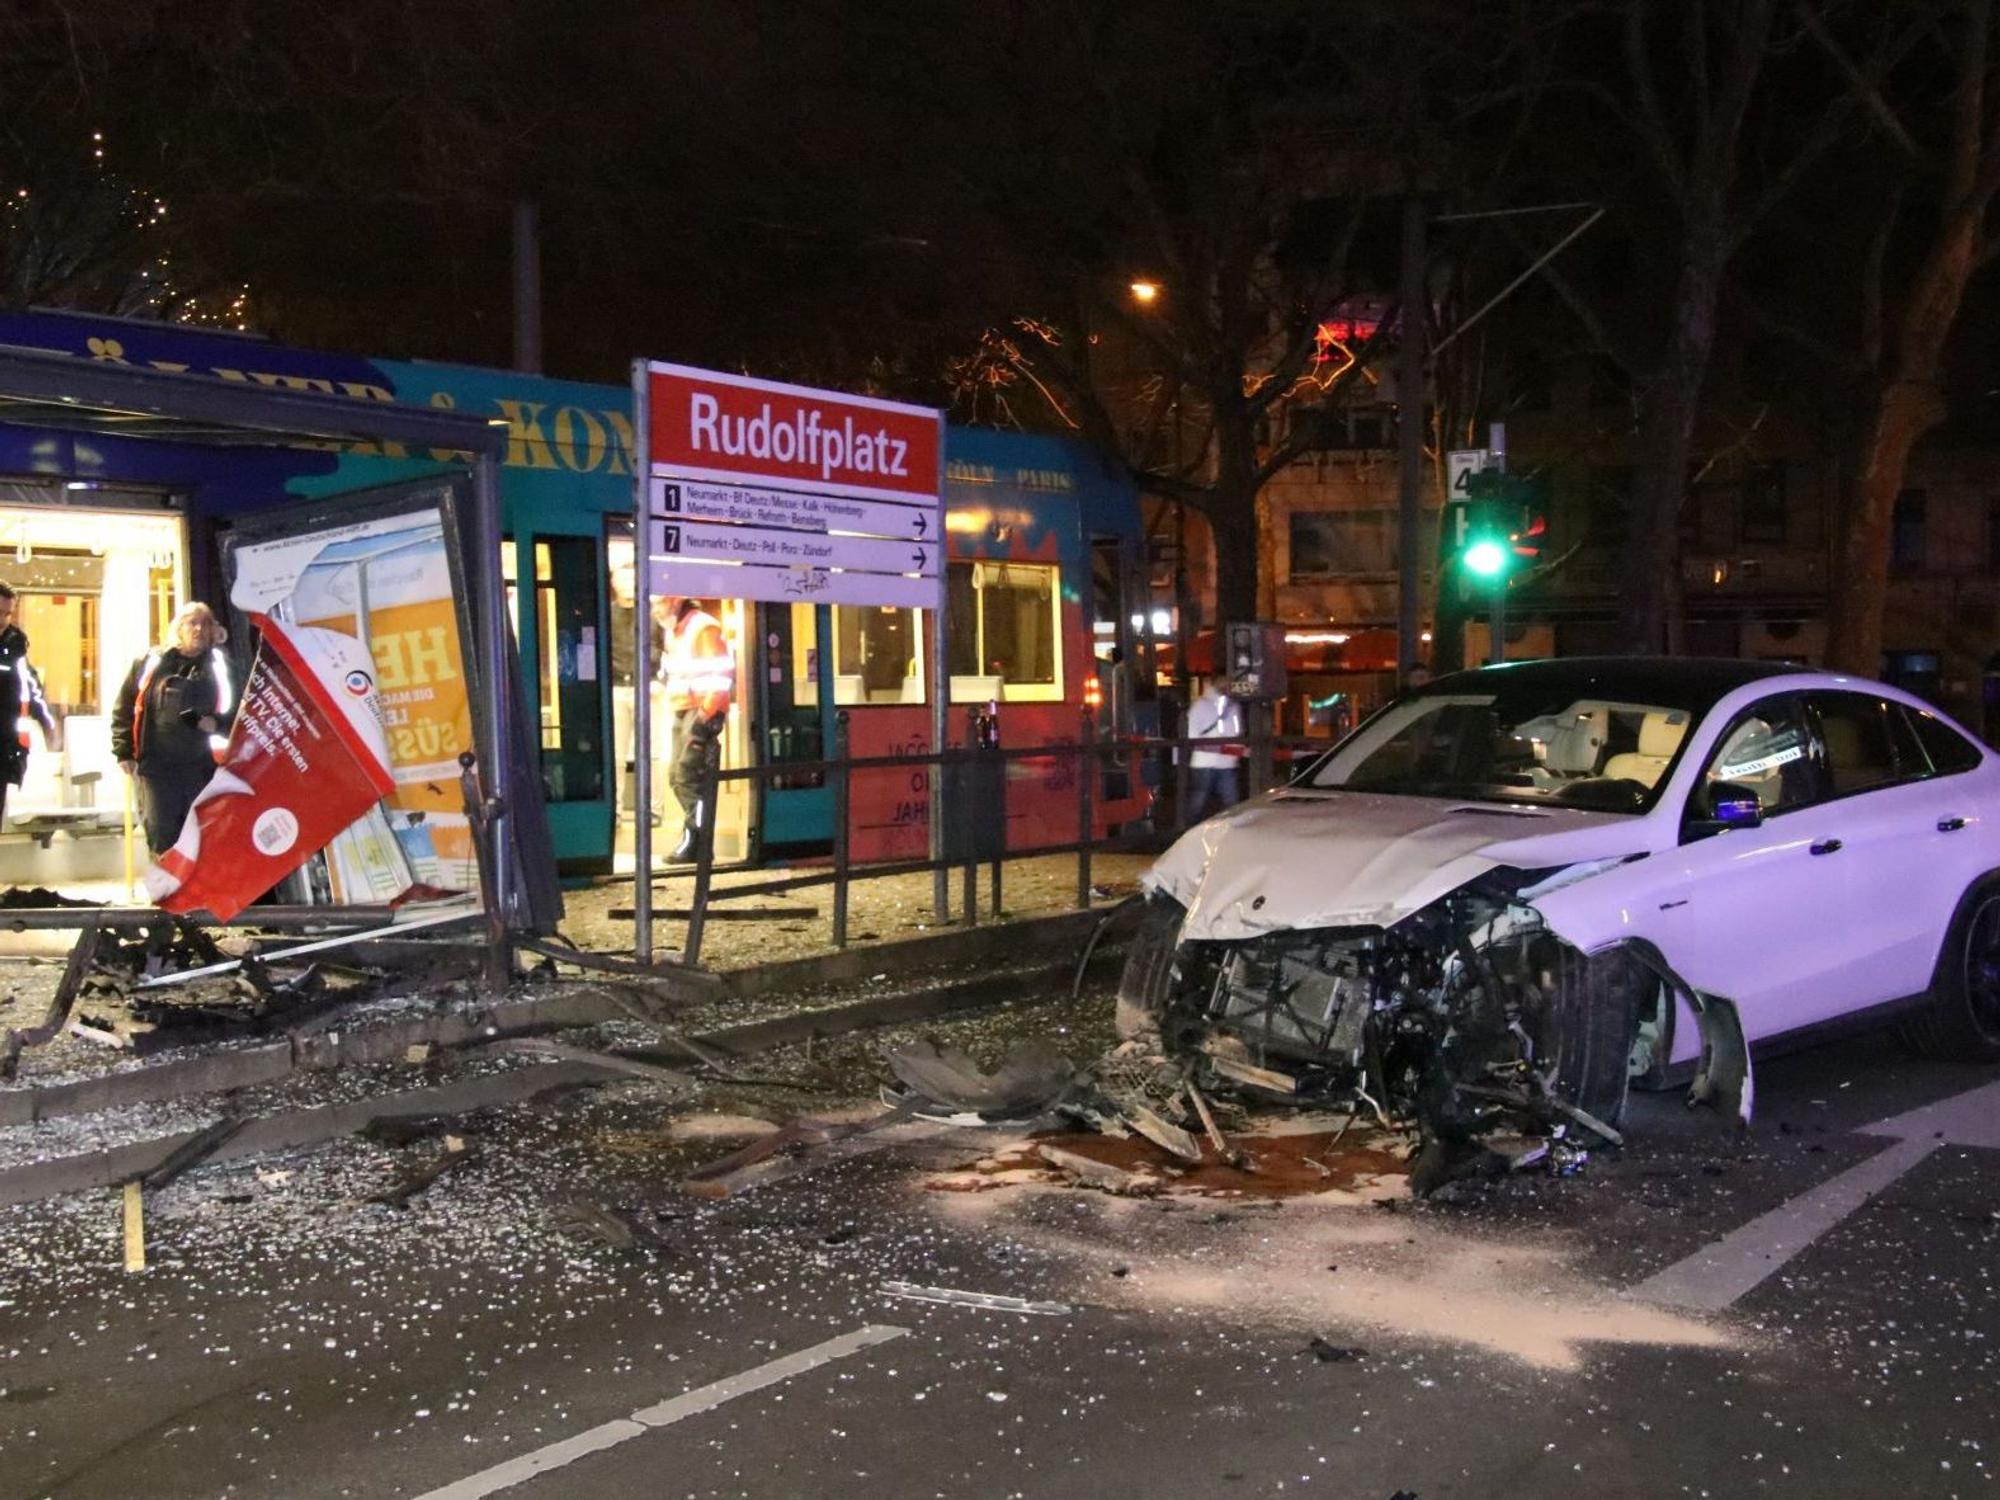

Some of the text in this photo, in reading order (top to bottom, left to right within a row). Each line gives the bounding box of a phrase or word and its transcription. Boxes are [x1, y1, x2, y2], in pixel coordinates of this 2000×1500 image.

[691, 391, 908, 480] Rudolfplatz
[686, 486, 728, 502] Neumarkt
[686, 535, 728, 548] Neumarkt
[733, 538, 757, 551] Deutz
[266, 716, 285, 739] Die
[281, 736, 309, 774] ersten
